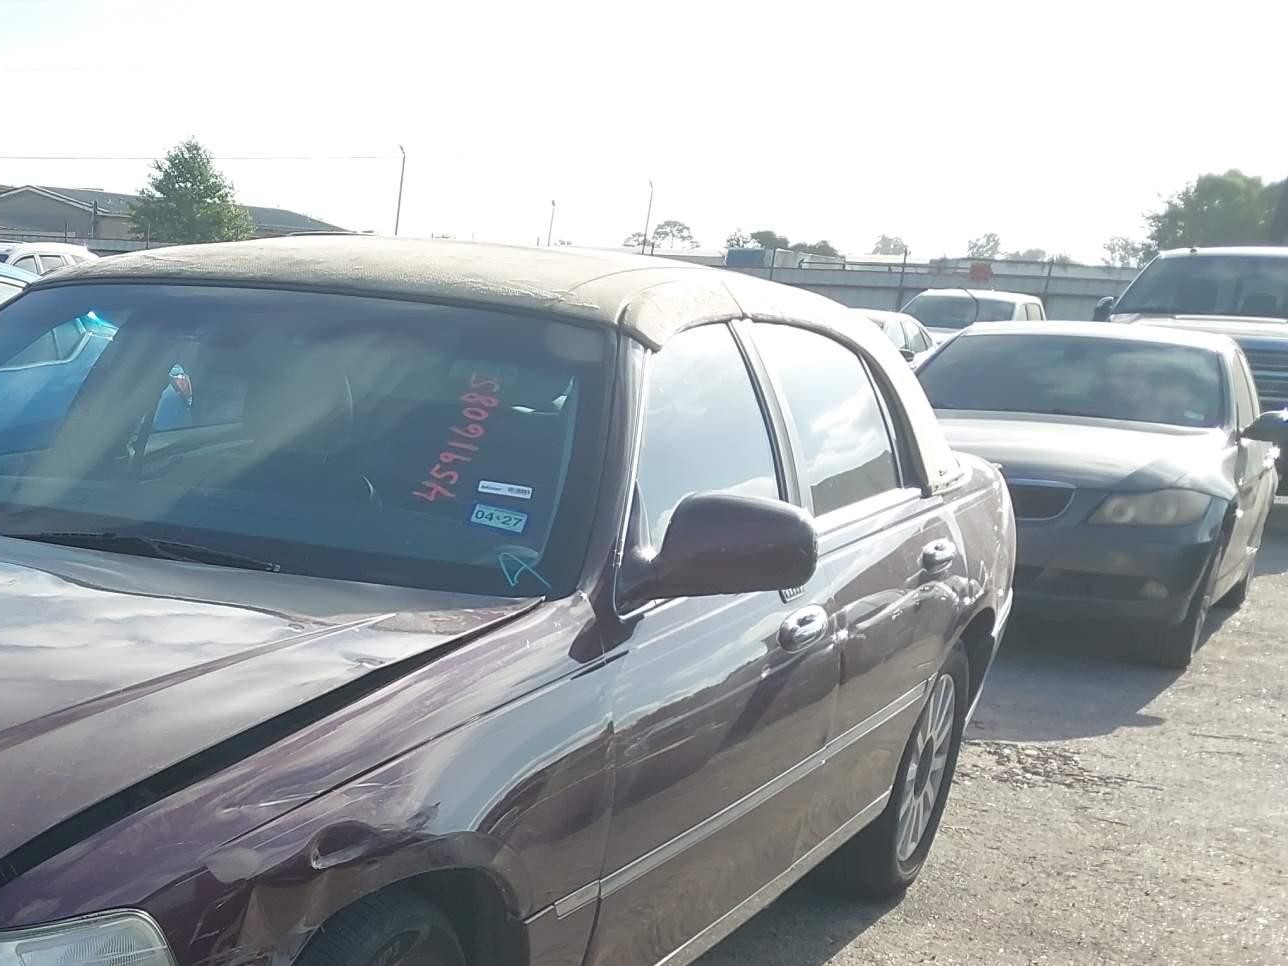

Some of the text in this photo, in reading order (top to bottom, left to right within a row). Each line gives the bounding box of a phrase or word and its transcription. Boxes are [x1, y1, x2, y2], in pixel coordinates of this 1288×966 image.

[412, 373, 500, 502] 45916085
[474, 509, 494, 522] 04
[501, 515, 523, 528] 27
